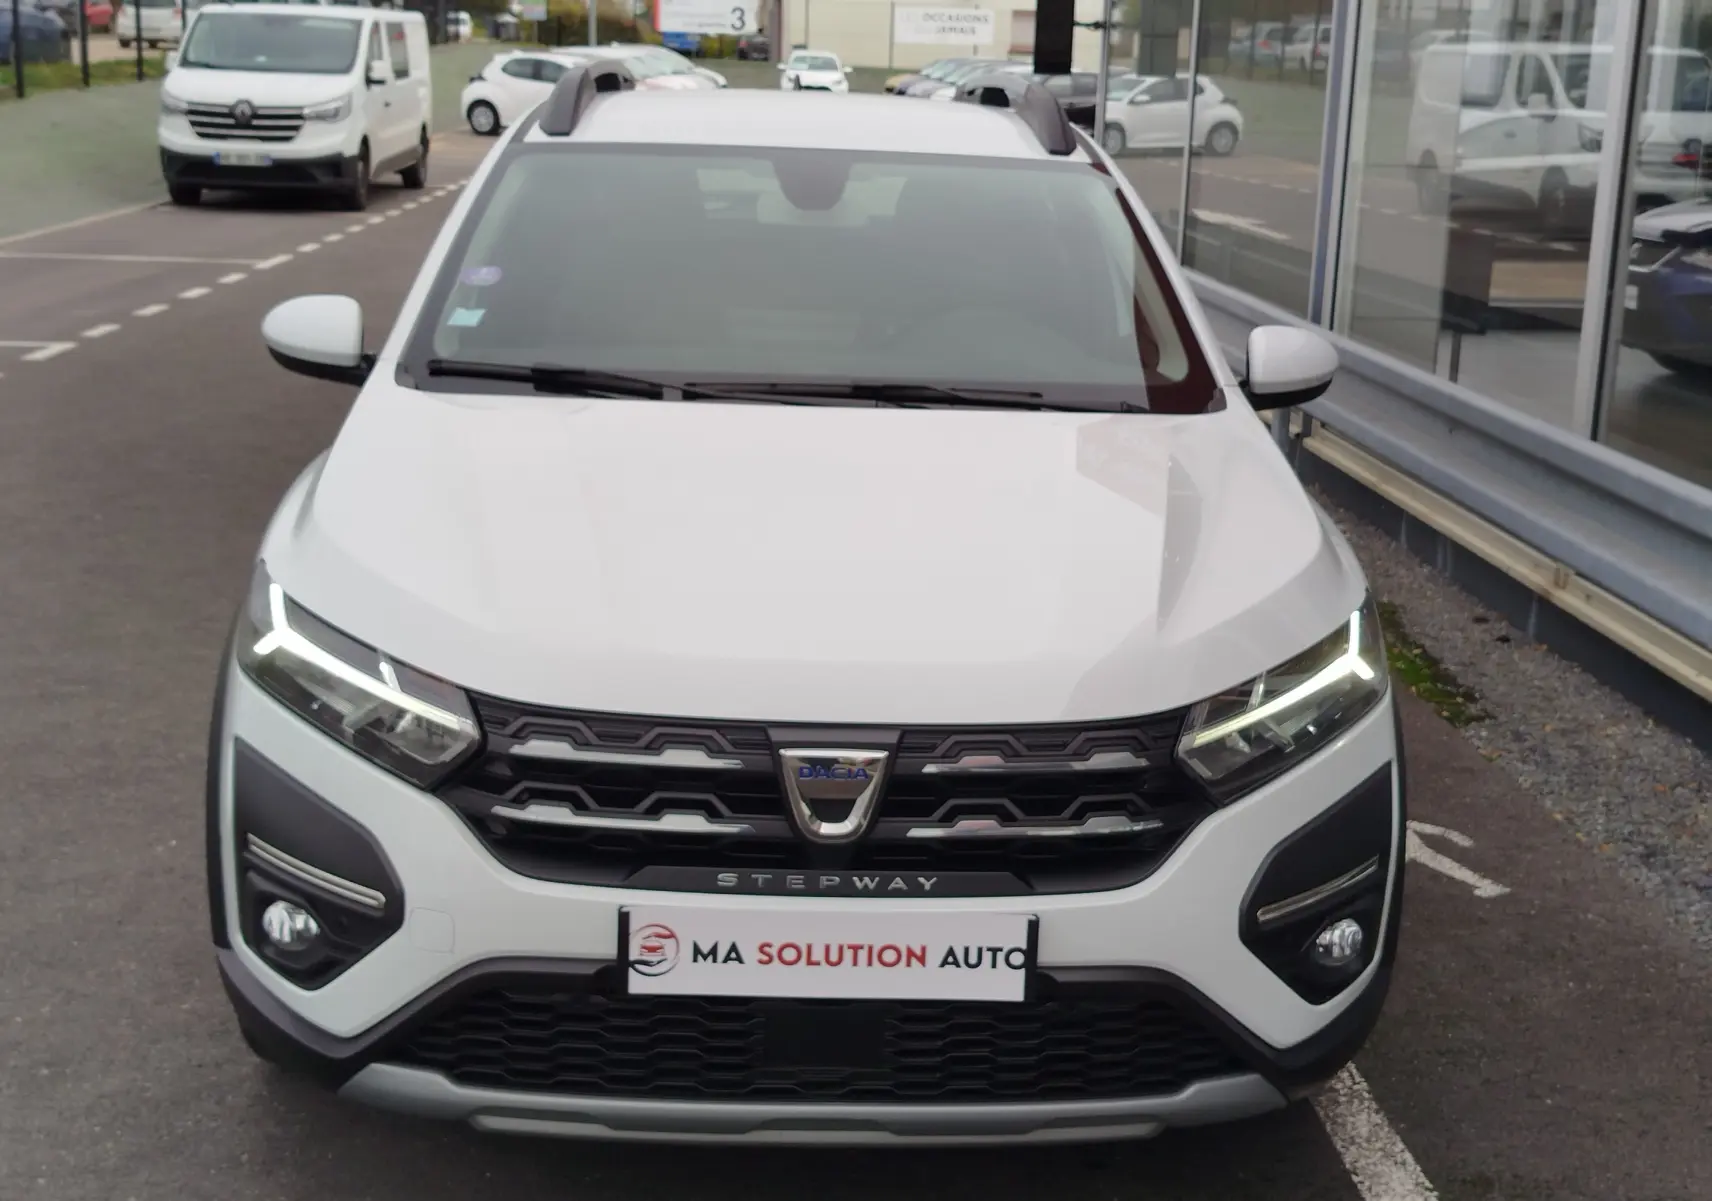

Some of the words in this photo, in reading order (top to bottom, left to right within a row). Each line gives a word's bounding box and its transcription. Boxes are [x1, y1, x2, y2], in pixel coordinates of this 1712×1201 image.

[731, 6, 746, 31] 3
[922, 13, 988, 23] OCCASIONS
[798, 765, 868, 779] DACIA
[717, 873, 938, 890] STEPWAY
[692, 940, 745, 965] MA
[757, 941, 926, 968] SOLUTION
[938, 945, 1027, 970] AUTO
